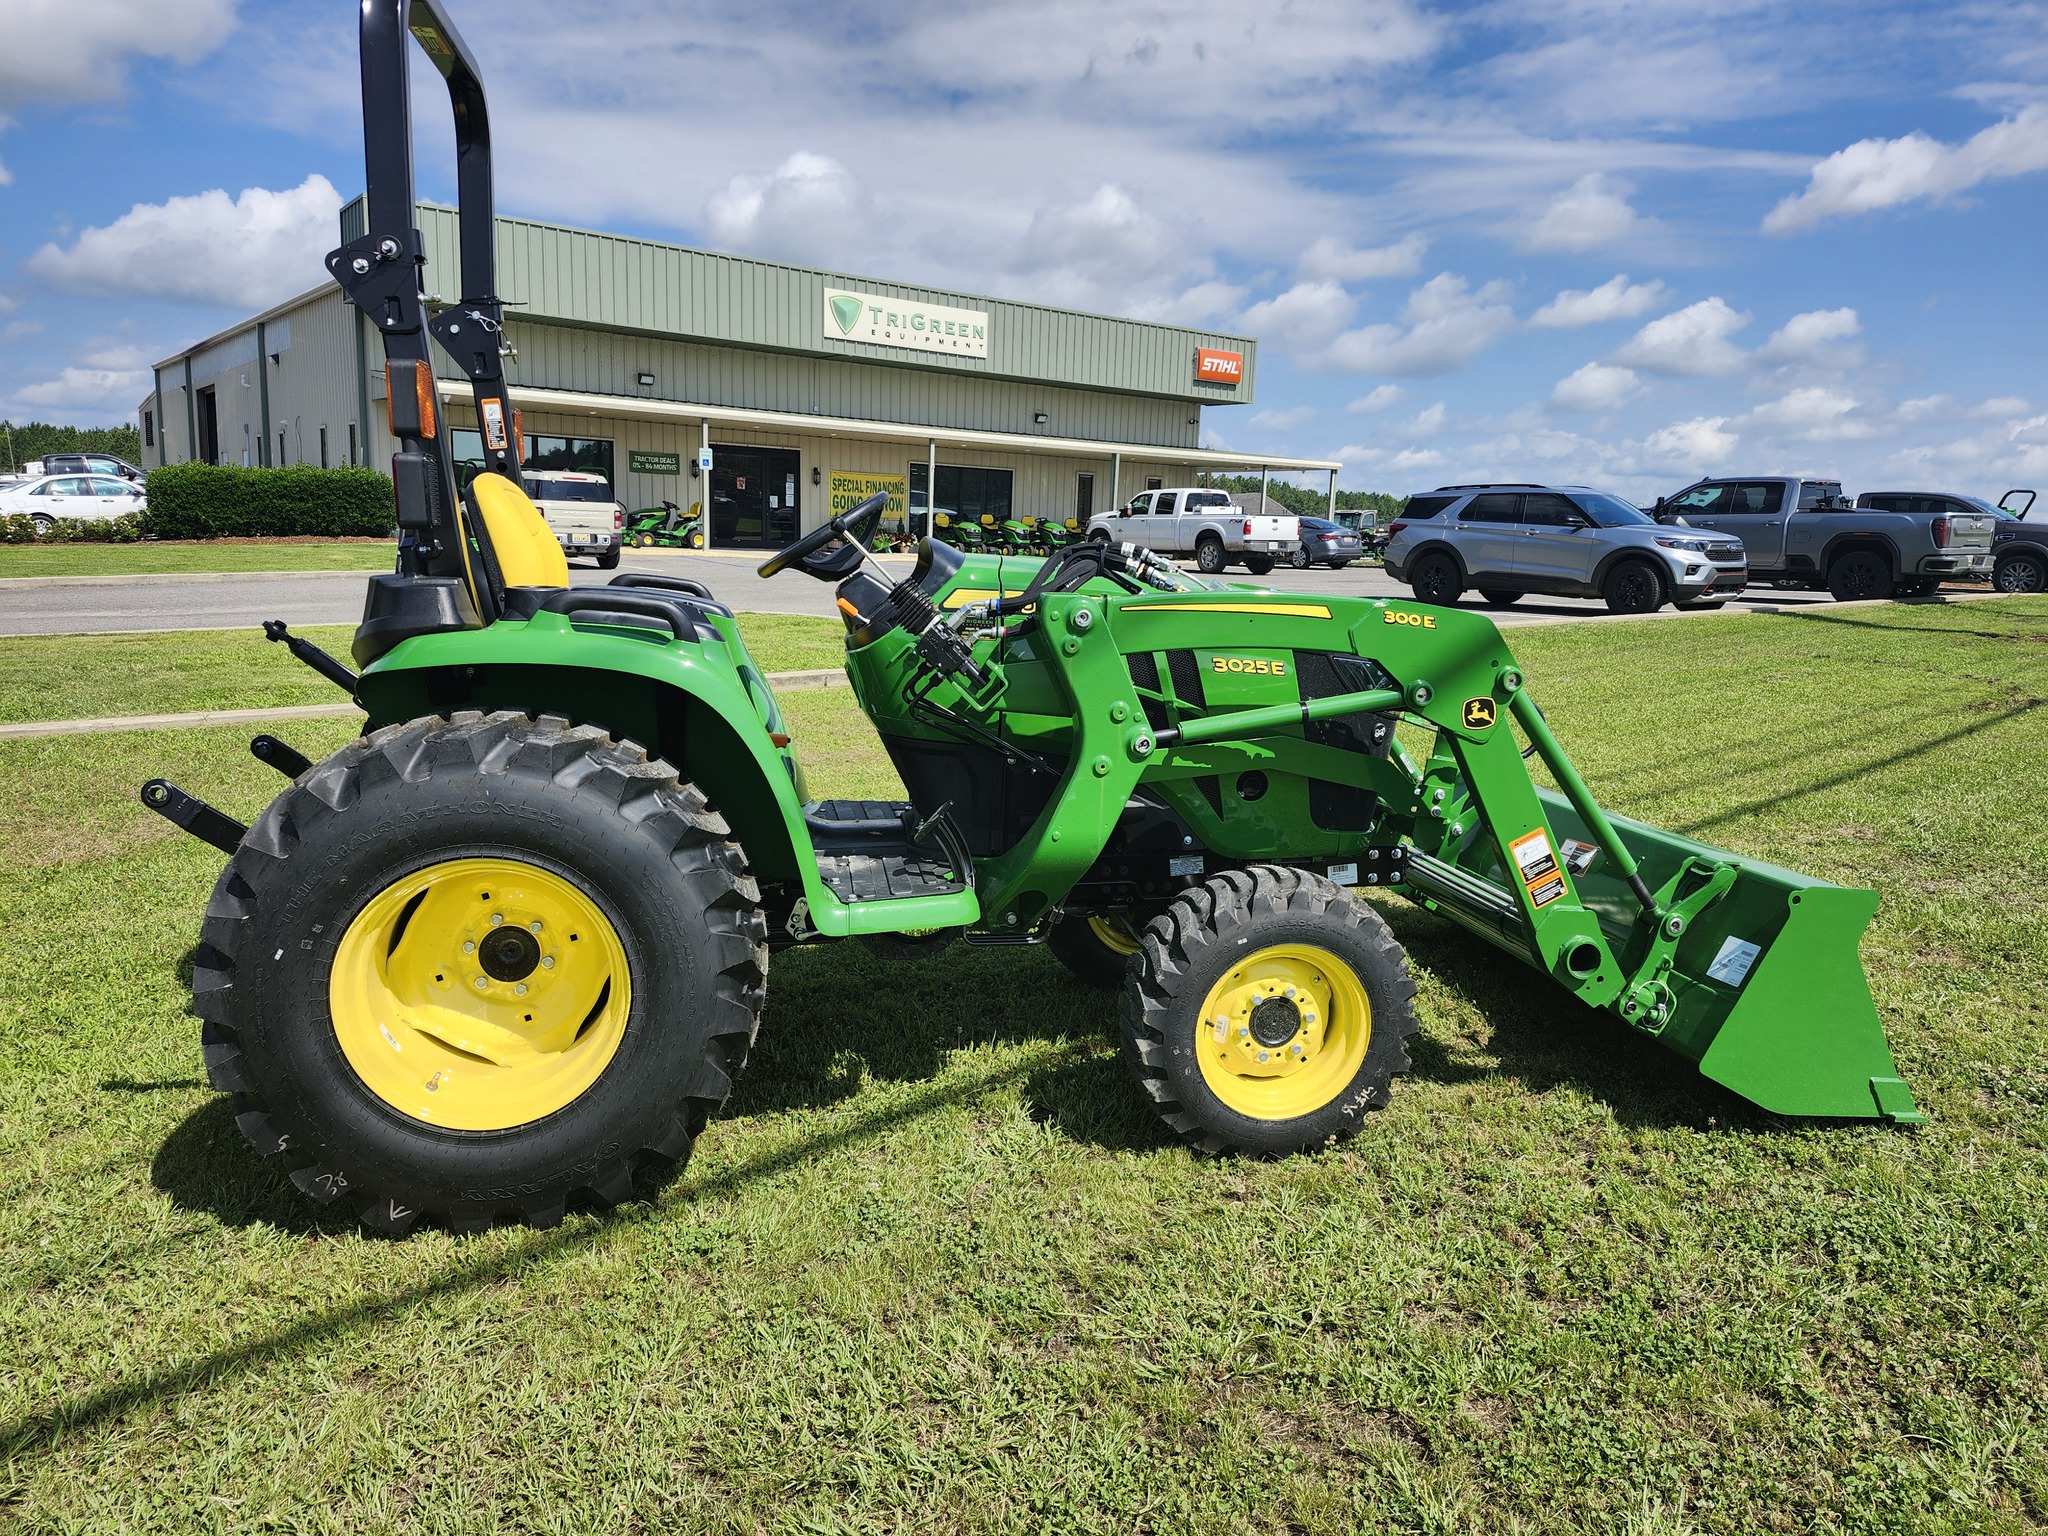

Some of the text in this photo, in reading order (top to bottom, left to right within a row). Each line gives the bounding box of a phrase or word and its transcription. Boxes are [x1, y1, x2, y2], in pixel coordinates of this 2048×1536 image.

[868, 305, 985, 339] TRIGREEN
[871, 329, 984, 350] EQUIPMENT
[1201, 357, 1239, 375] STIHL
[634, 455, 659, 463] TRACTOR
[832, 477, 905, 495] SPECIAL FINANCING
[278, 800, 563, 926] THE MARATHONER
